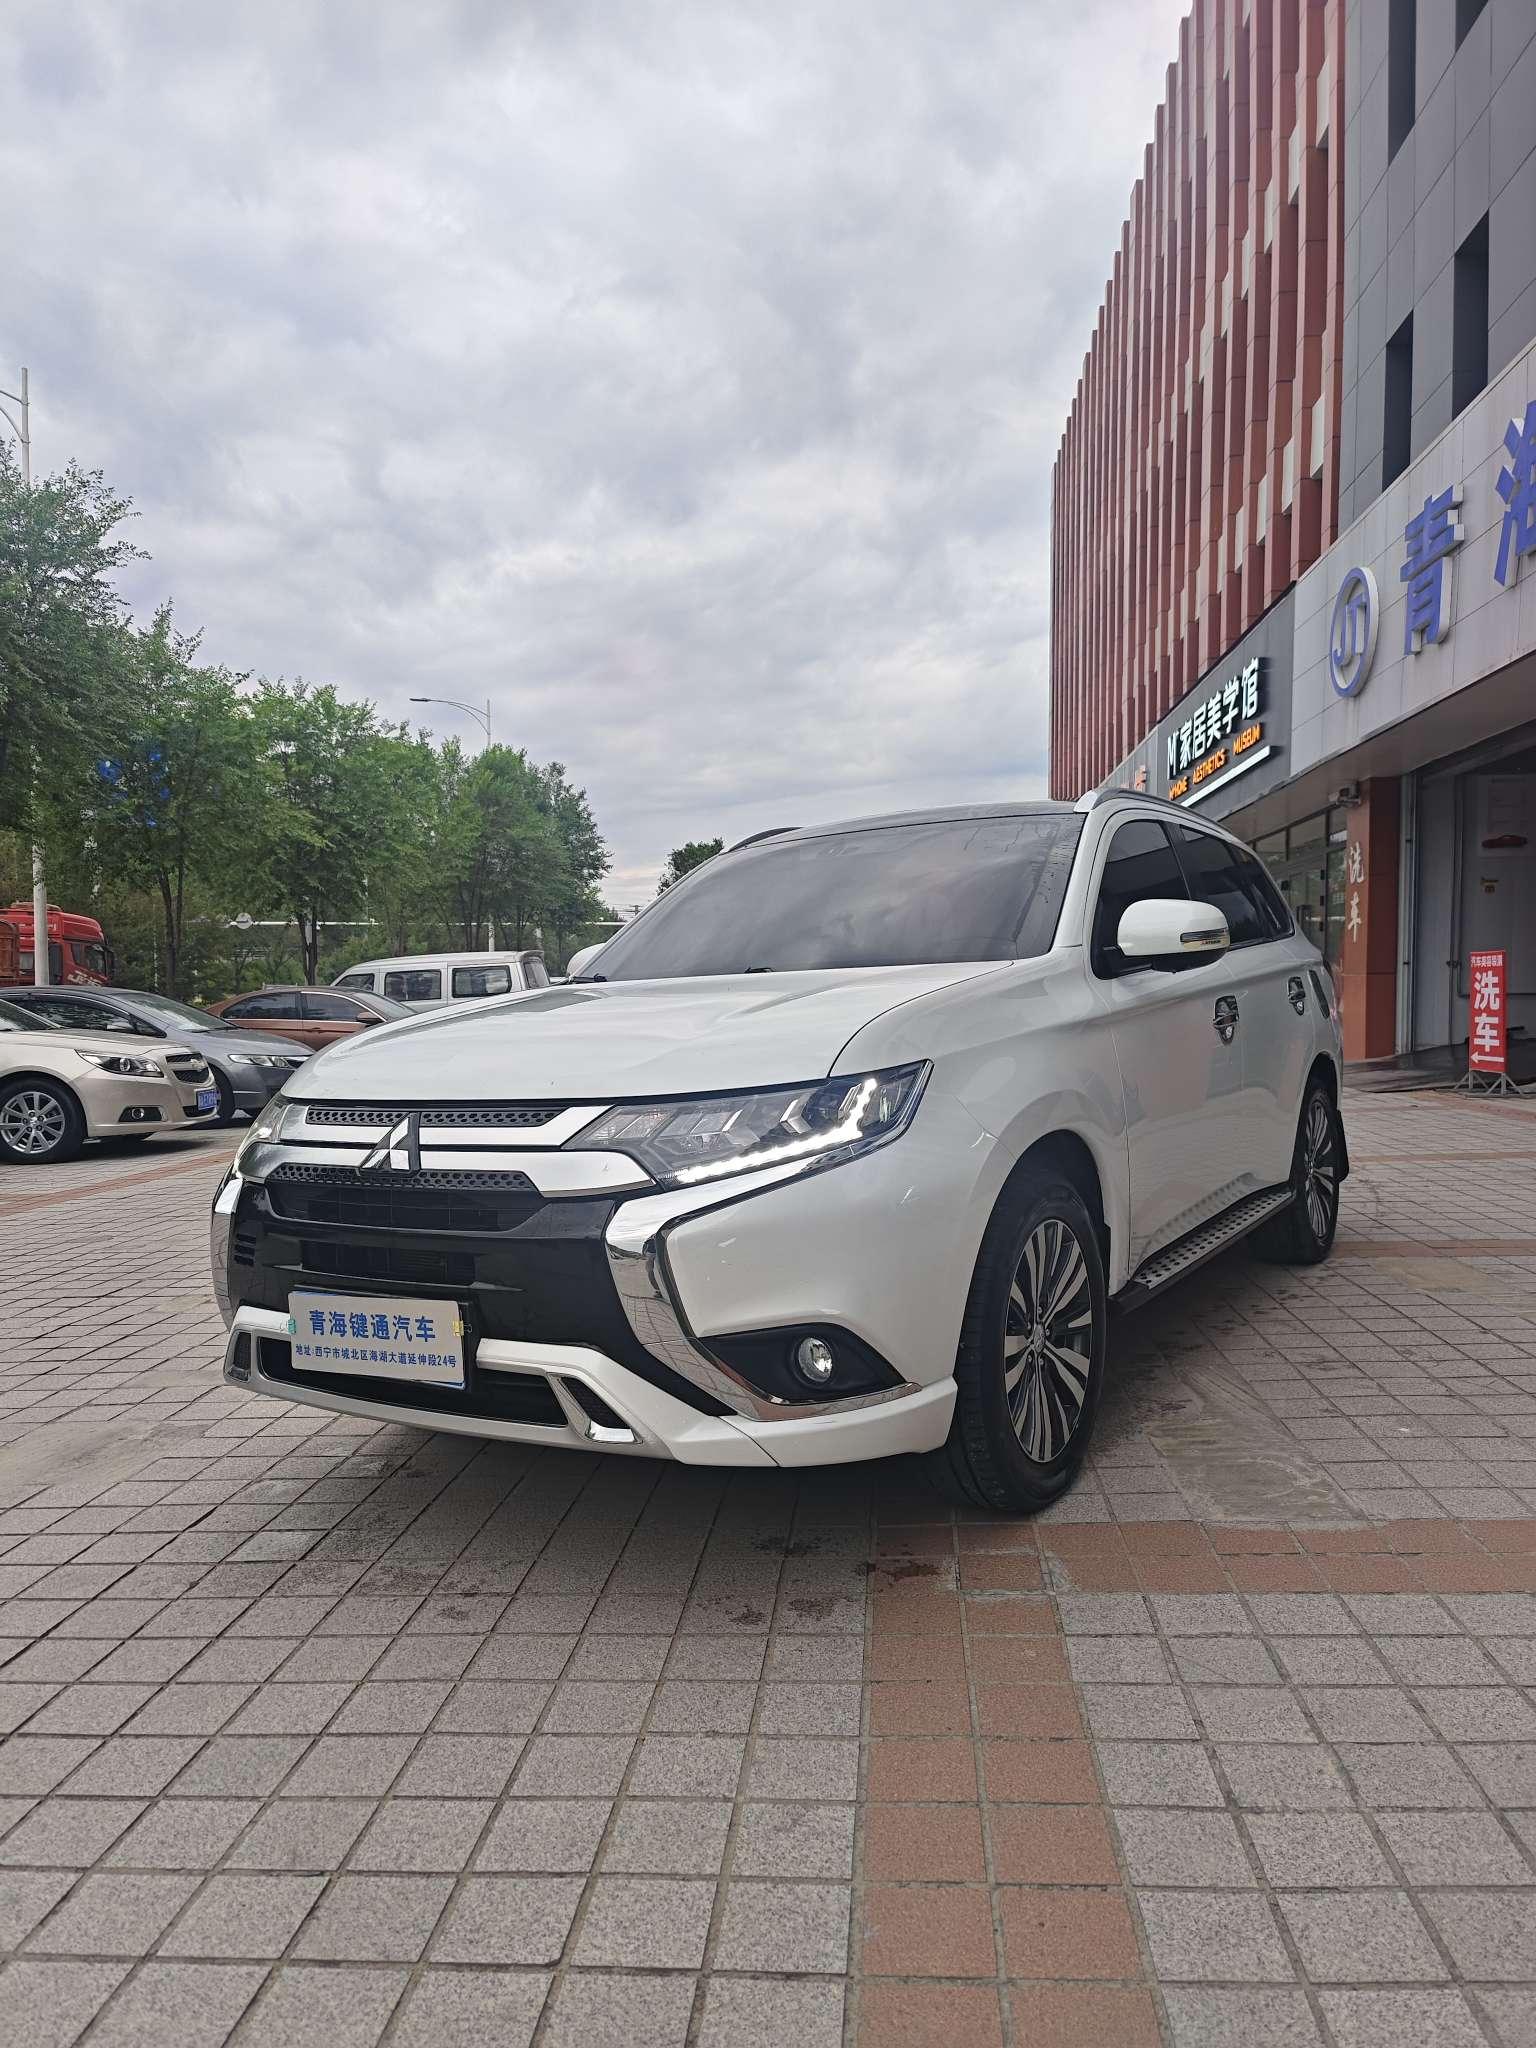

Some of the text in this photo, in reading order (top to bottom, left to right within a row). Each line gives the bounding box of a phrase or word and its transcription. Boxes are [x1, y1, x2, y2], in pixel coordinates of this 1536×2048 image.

[1233, 721, 1262, 756] MUSEUM
[1473, 970, 1500, 1052] 洗车
[309, 1309, 436, 1343] 青海键通汽车
